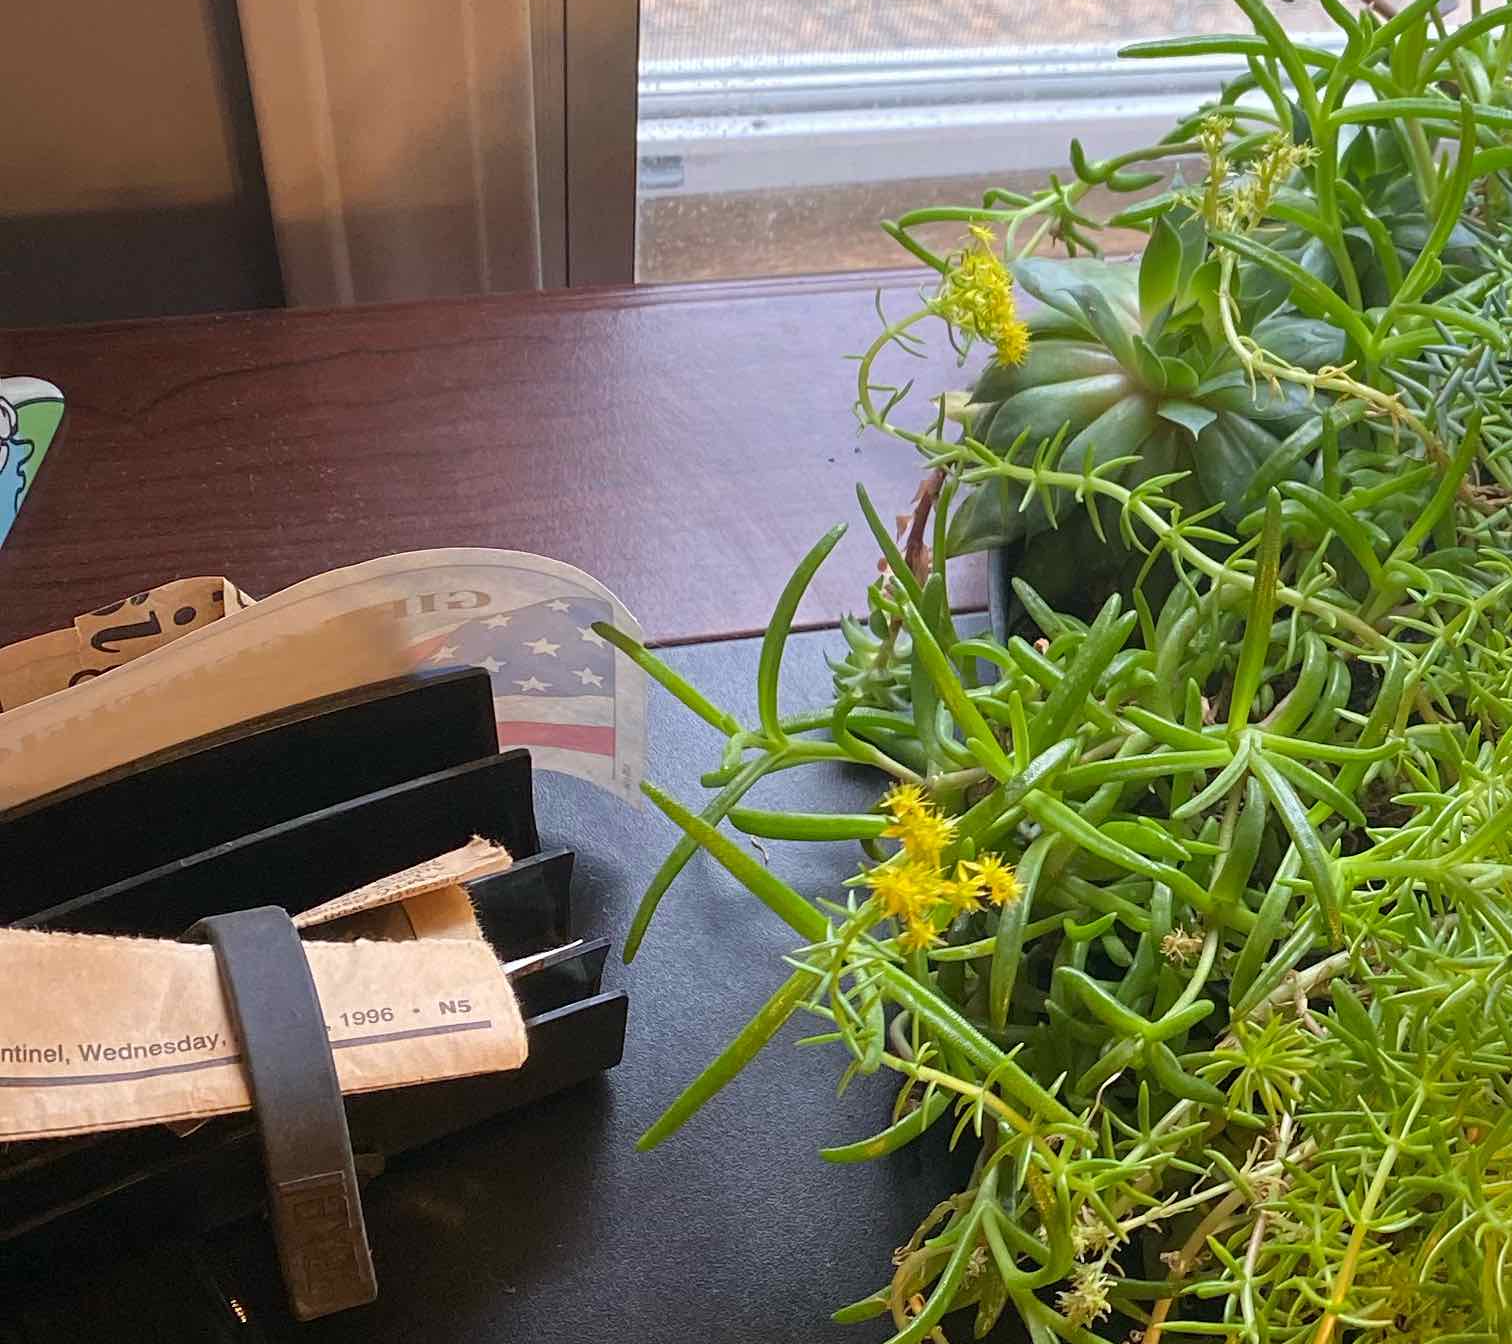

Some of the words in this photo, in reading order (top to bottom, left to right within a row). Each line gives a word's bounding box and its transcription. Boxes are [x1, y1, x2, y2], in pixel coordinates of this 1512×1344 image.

[78, 1032, 227, 1063] Wednesday,
[339, 1007, 394, 1027] 1996
[438, 999, 472, 1016] N5
